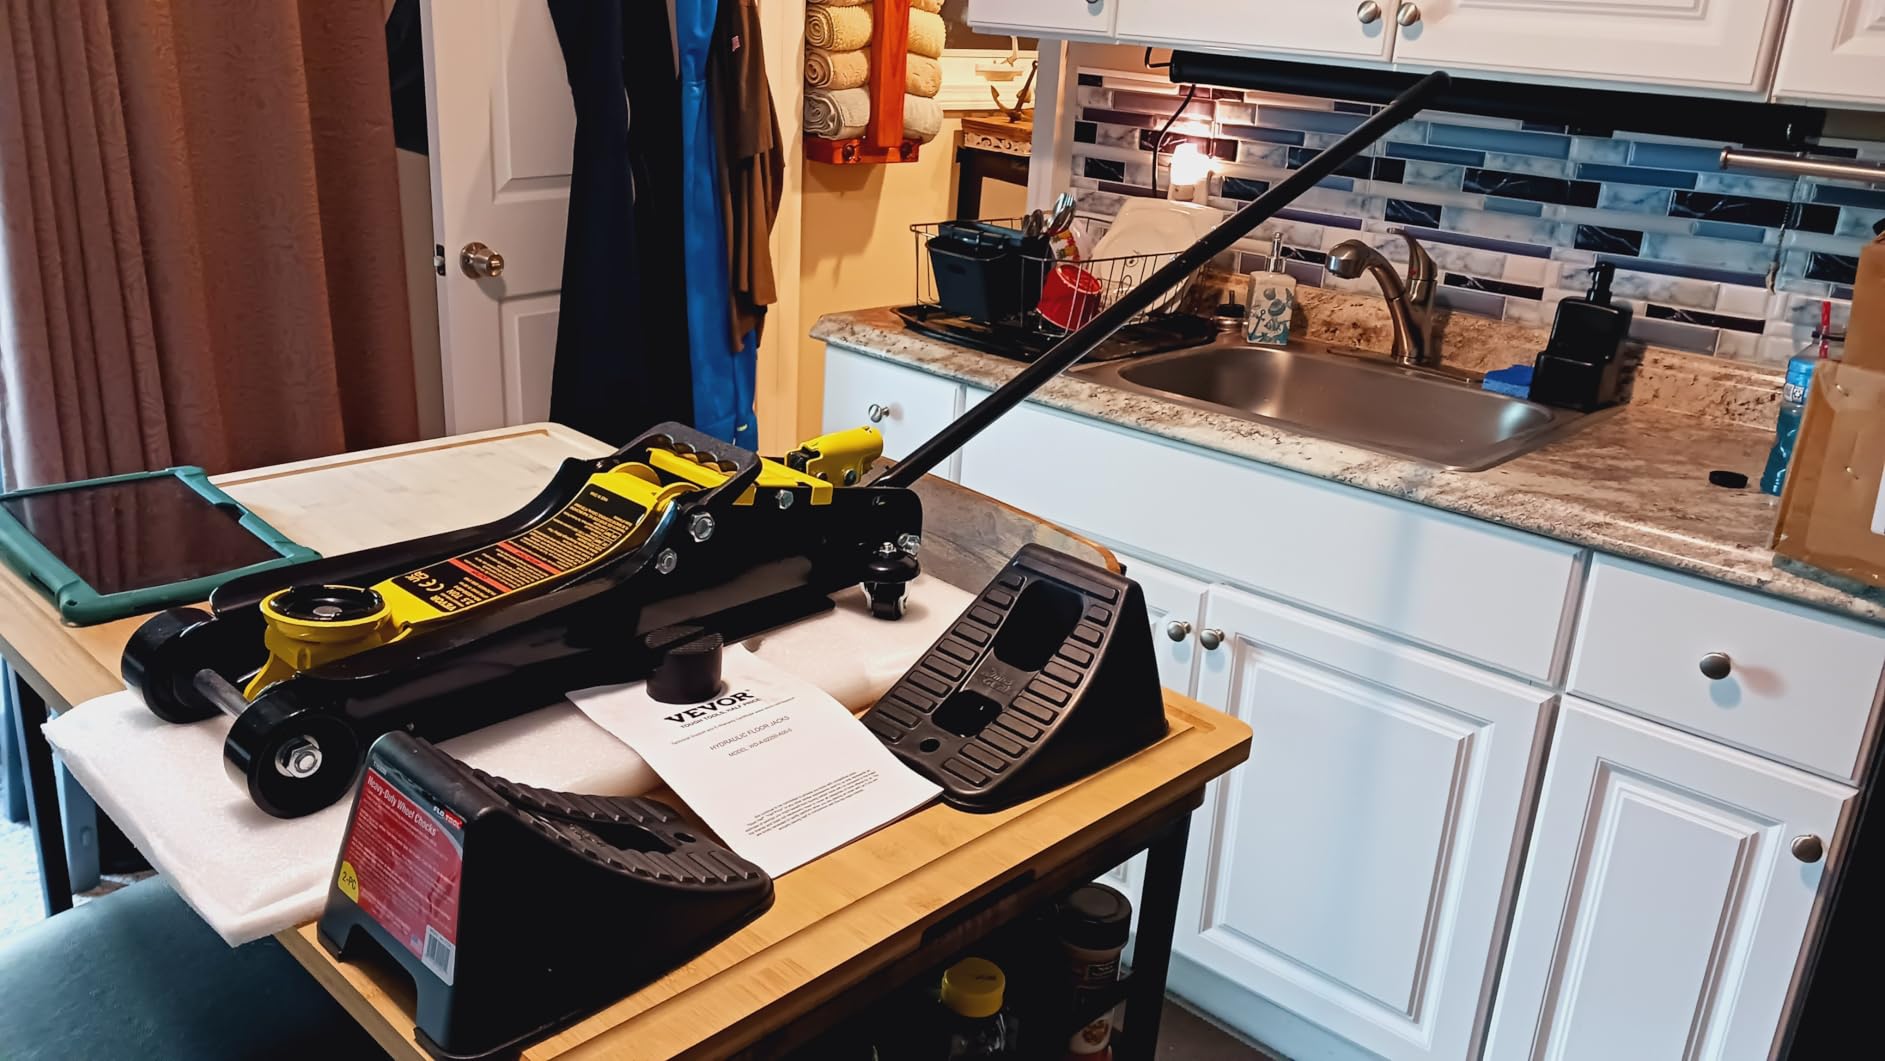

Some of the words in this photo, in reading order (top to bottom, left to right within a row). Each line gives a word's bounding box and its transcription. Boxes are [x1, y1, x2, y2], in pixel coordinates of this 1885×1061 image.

[664, 692, 754, 724] VEVOR
[680, 718, 703, 728] TOUGH
[726, 704, 742, 713] HALF
[743, 698, 761, 706] PRICE
[710, 732, 748, 751] HYDRAULIC
[748, 723, 769, 736] FLOOR
[770, 715, 790, 728] JACKS
[368, 776, 397, 807] Heavy-Duty
[396, 800, 415, 818] Wheel
[414, 812, 436, 836] Chocks
[342, 872, 357, 890] 2-PC
